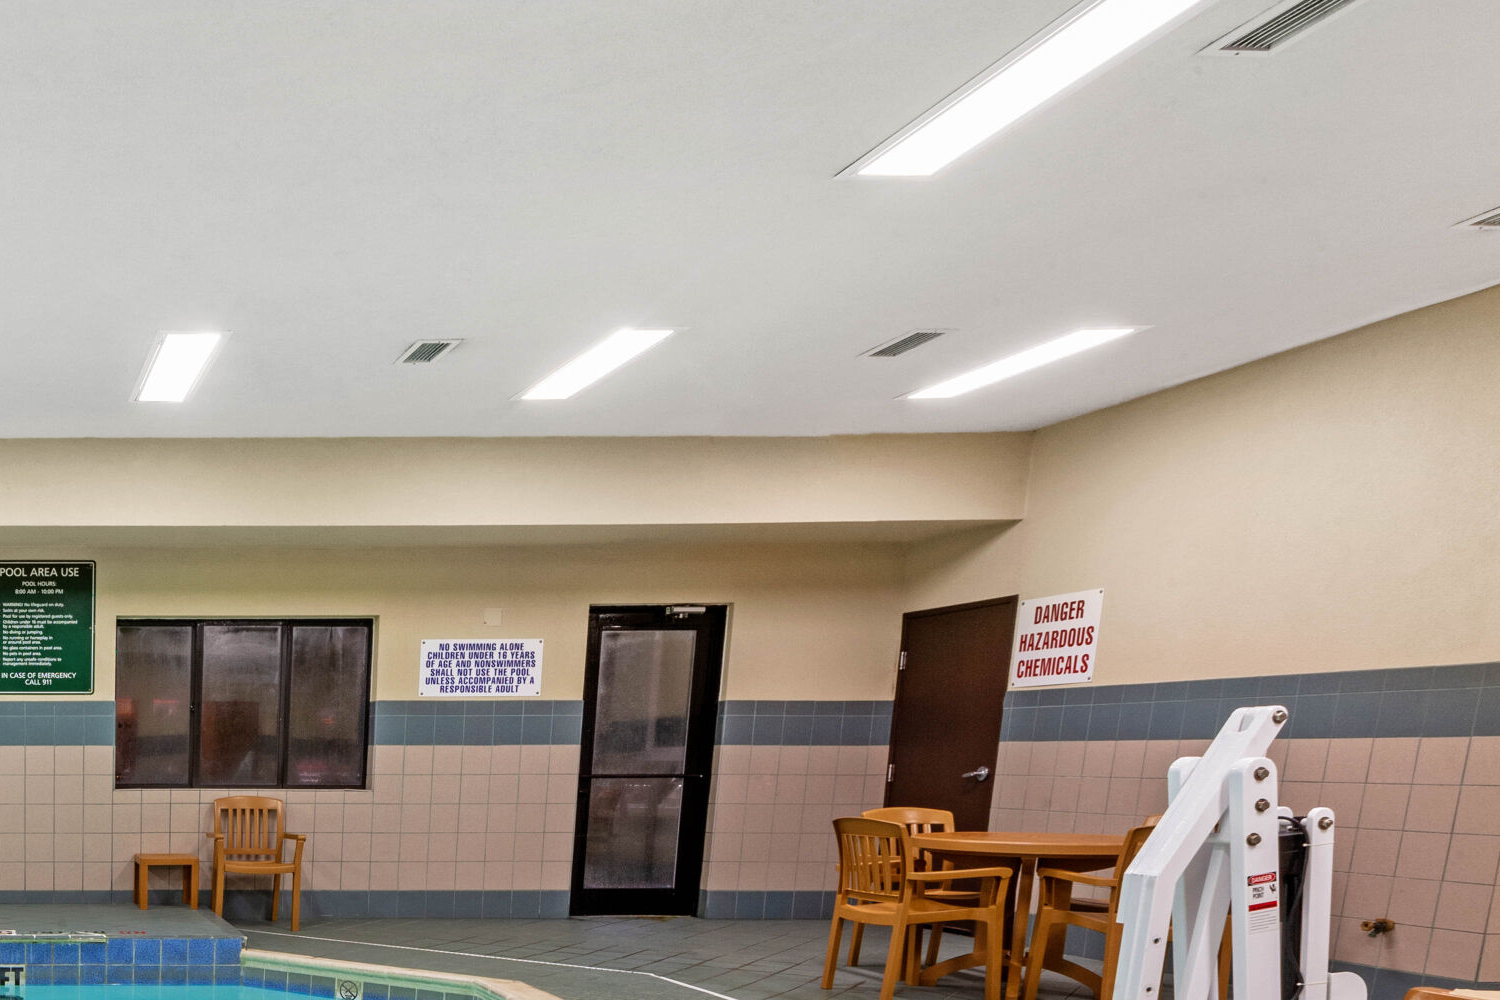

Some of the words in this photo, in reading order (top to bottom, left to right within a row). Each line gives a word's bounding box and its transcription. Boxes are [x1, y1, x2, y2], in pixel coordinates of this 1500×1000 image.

[0, 567, 27, 577] POOL
[30, 567, 58, 577] AREA
[61, 567, 80, 577] USE
[1034, 600, 1085, 624] DANGER
[1019, 626, 1094, 652] HAZARDOUS
[439, 643, 450, 651] NO
[453, 643, 497, 651] SWIMMING
[500, 643, 524, 651] ALONE
[428, 652, 465, 660] CHILDREN
[469, 652, 494, 660] UNDER
[511, 651, 535, 659] YEARS
[426, 660, 435, 668] OF
[438, 660, 452, 668] AGE
[1017, 654, 1089, 678] CHEMICALS
[494, 668, 507, 676] THE
[511, 668, 530, 676] POOL
[425, 677, 455, 685] UNLESS
[440, 685, 492, 693] RESPONSIBLE
[495, 685, 519, 693] ADULT
[0, 967, 24, 985] FT
